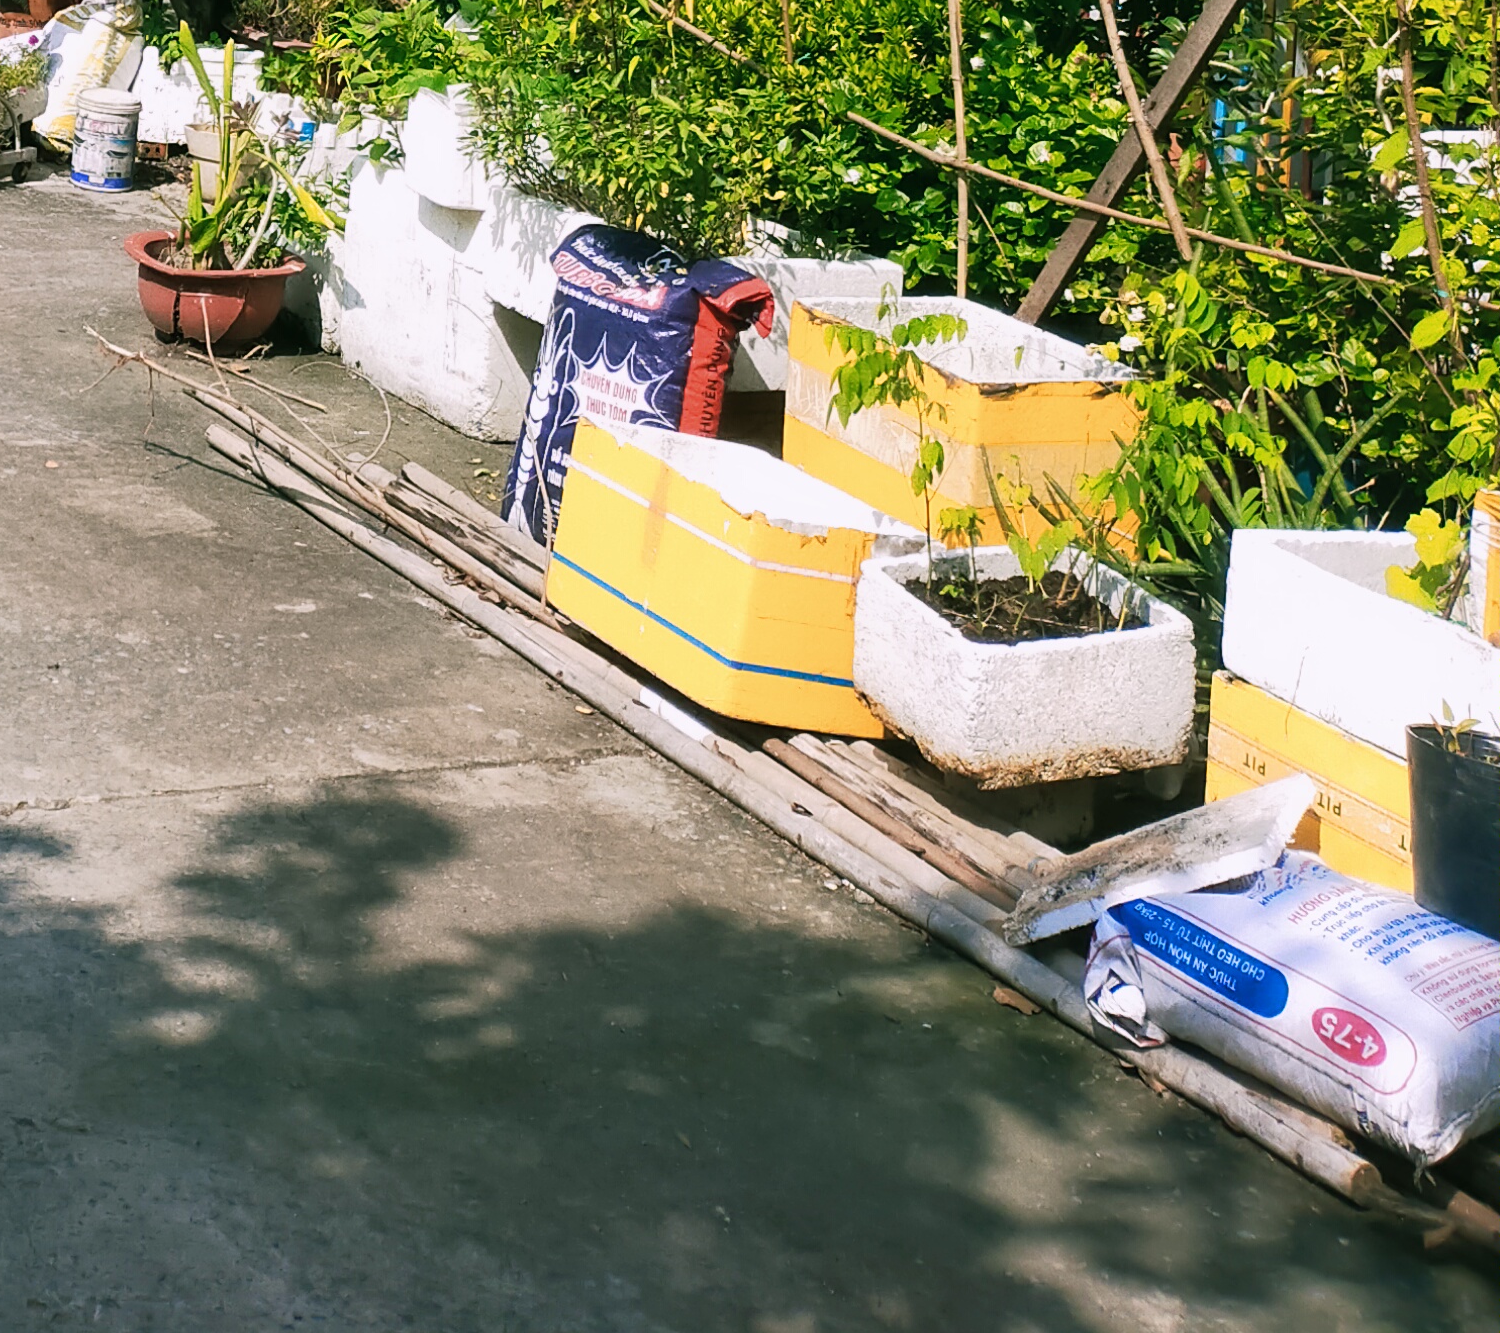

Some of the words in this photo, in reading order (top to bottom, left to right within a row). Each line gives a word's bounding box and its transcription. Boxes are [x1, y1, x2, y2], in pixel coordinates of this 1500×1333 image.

[699, 379, 719, 437] HUYÊN
[1243, 753, 1266, 776] PIT
[1317, 792, 1342, 817] PIT
[1162, 918, 1176, 931] 15
[1192, 933, 1216, 956] THỊT
[1352, 933, 1373, 949] Cho
[1217, 949, 1241, 967] HEO
[1241, 965, 1266, 981] CHO
[1320, 1013, 1379, 1059] 4-75
